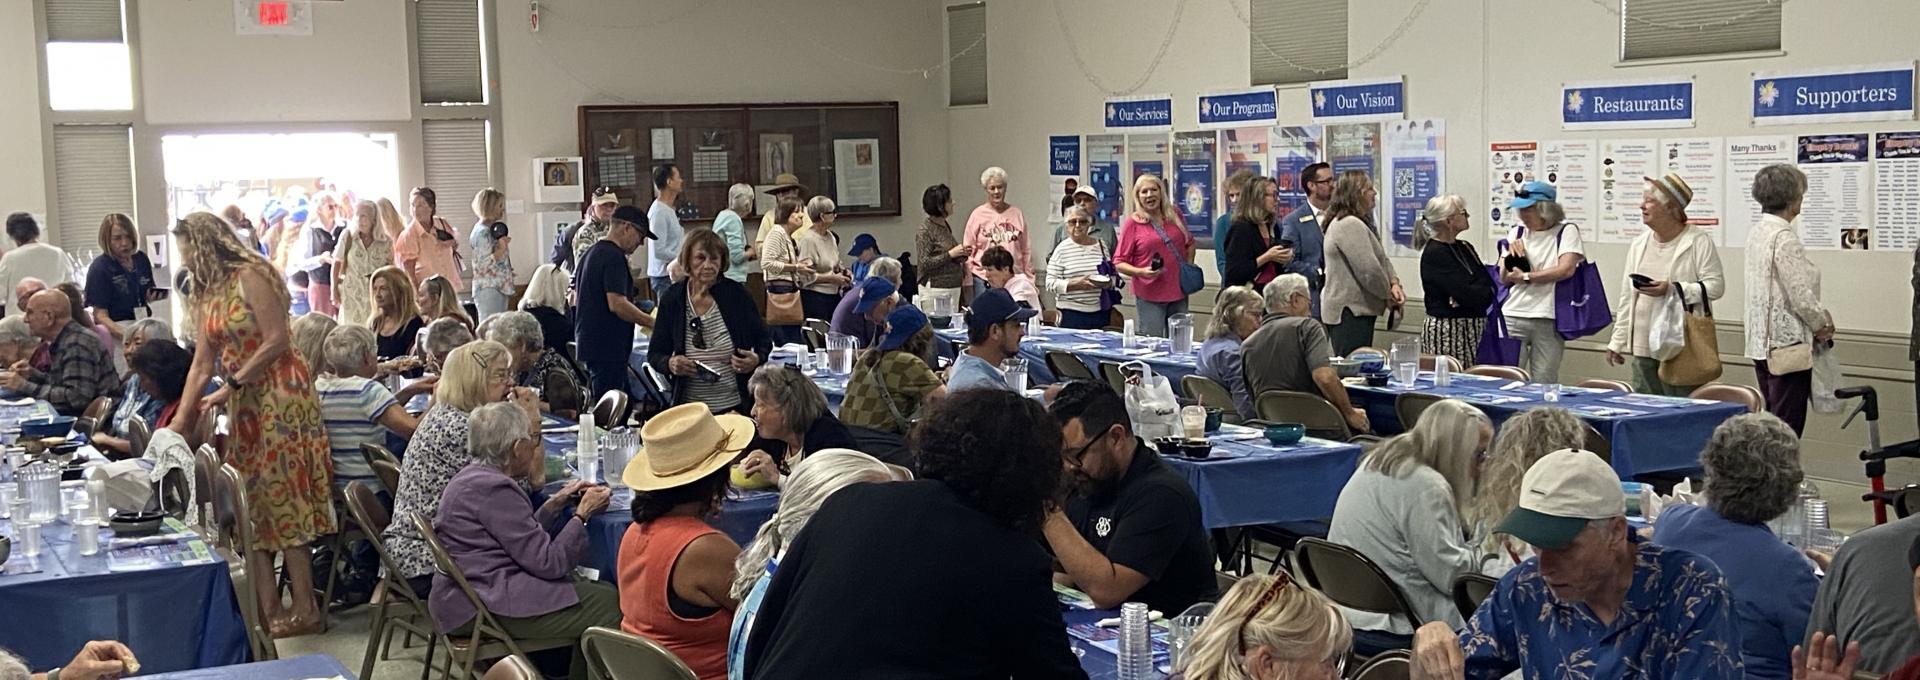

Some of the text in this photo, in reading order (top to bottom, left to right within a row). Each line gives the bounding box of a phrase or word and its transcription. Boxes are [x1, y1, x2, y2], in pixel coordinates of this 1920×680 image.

[1336, 92, 1395, 110] Our Vision
[1796, 84, 1897, 108] Supporters
[1213, 101, 1276, 117] Our Programs
[1593, 95, 1685, 114] Restaurants
[1118, 106, 1169, 121] Our Services
[1187, 137, 1202, 145] Starts
[1202, 136, 1216, 144] Here
[1054, 147, 1075, 161] Empty
[1731, 143, 1777, 154] Many Thanks
[1055, 160, 1074, 171] Bowls
